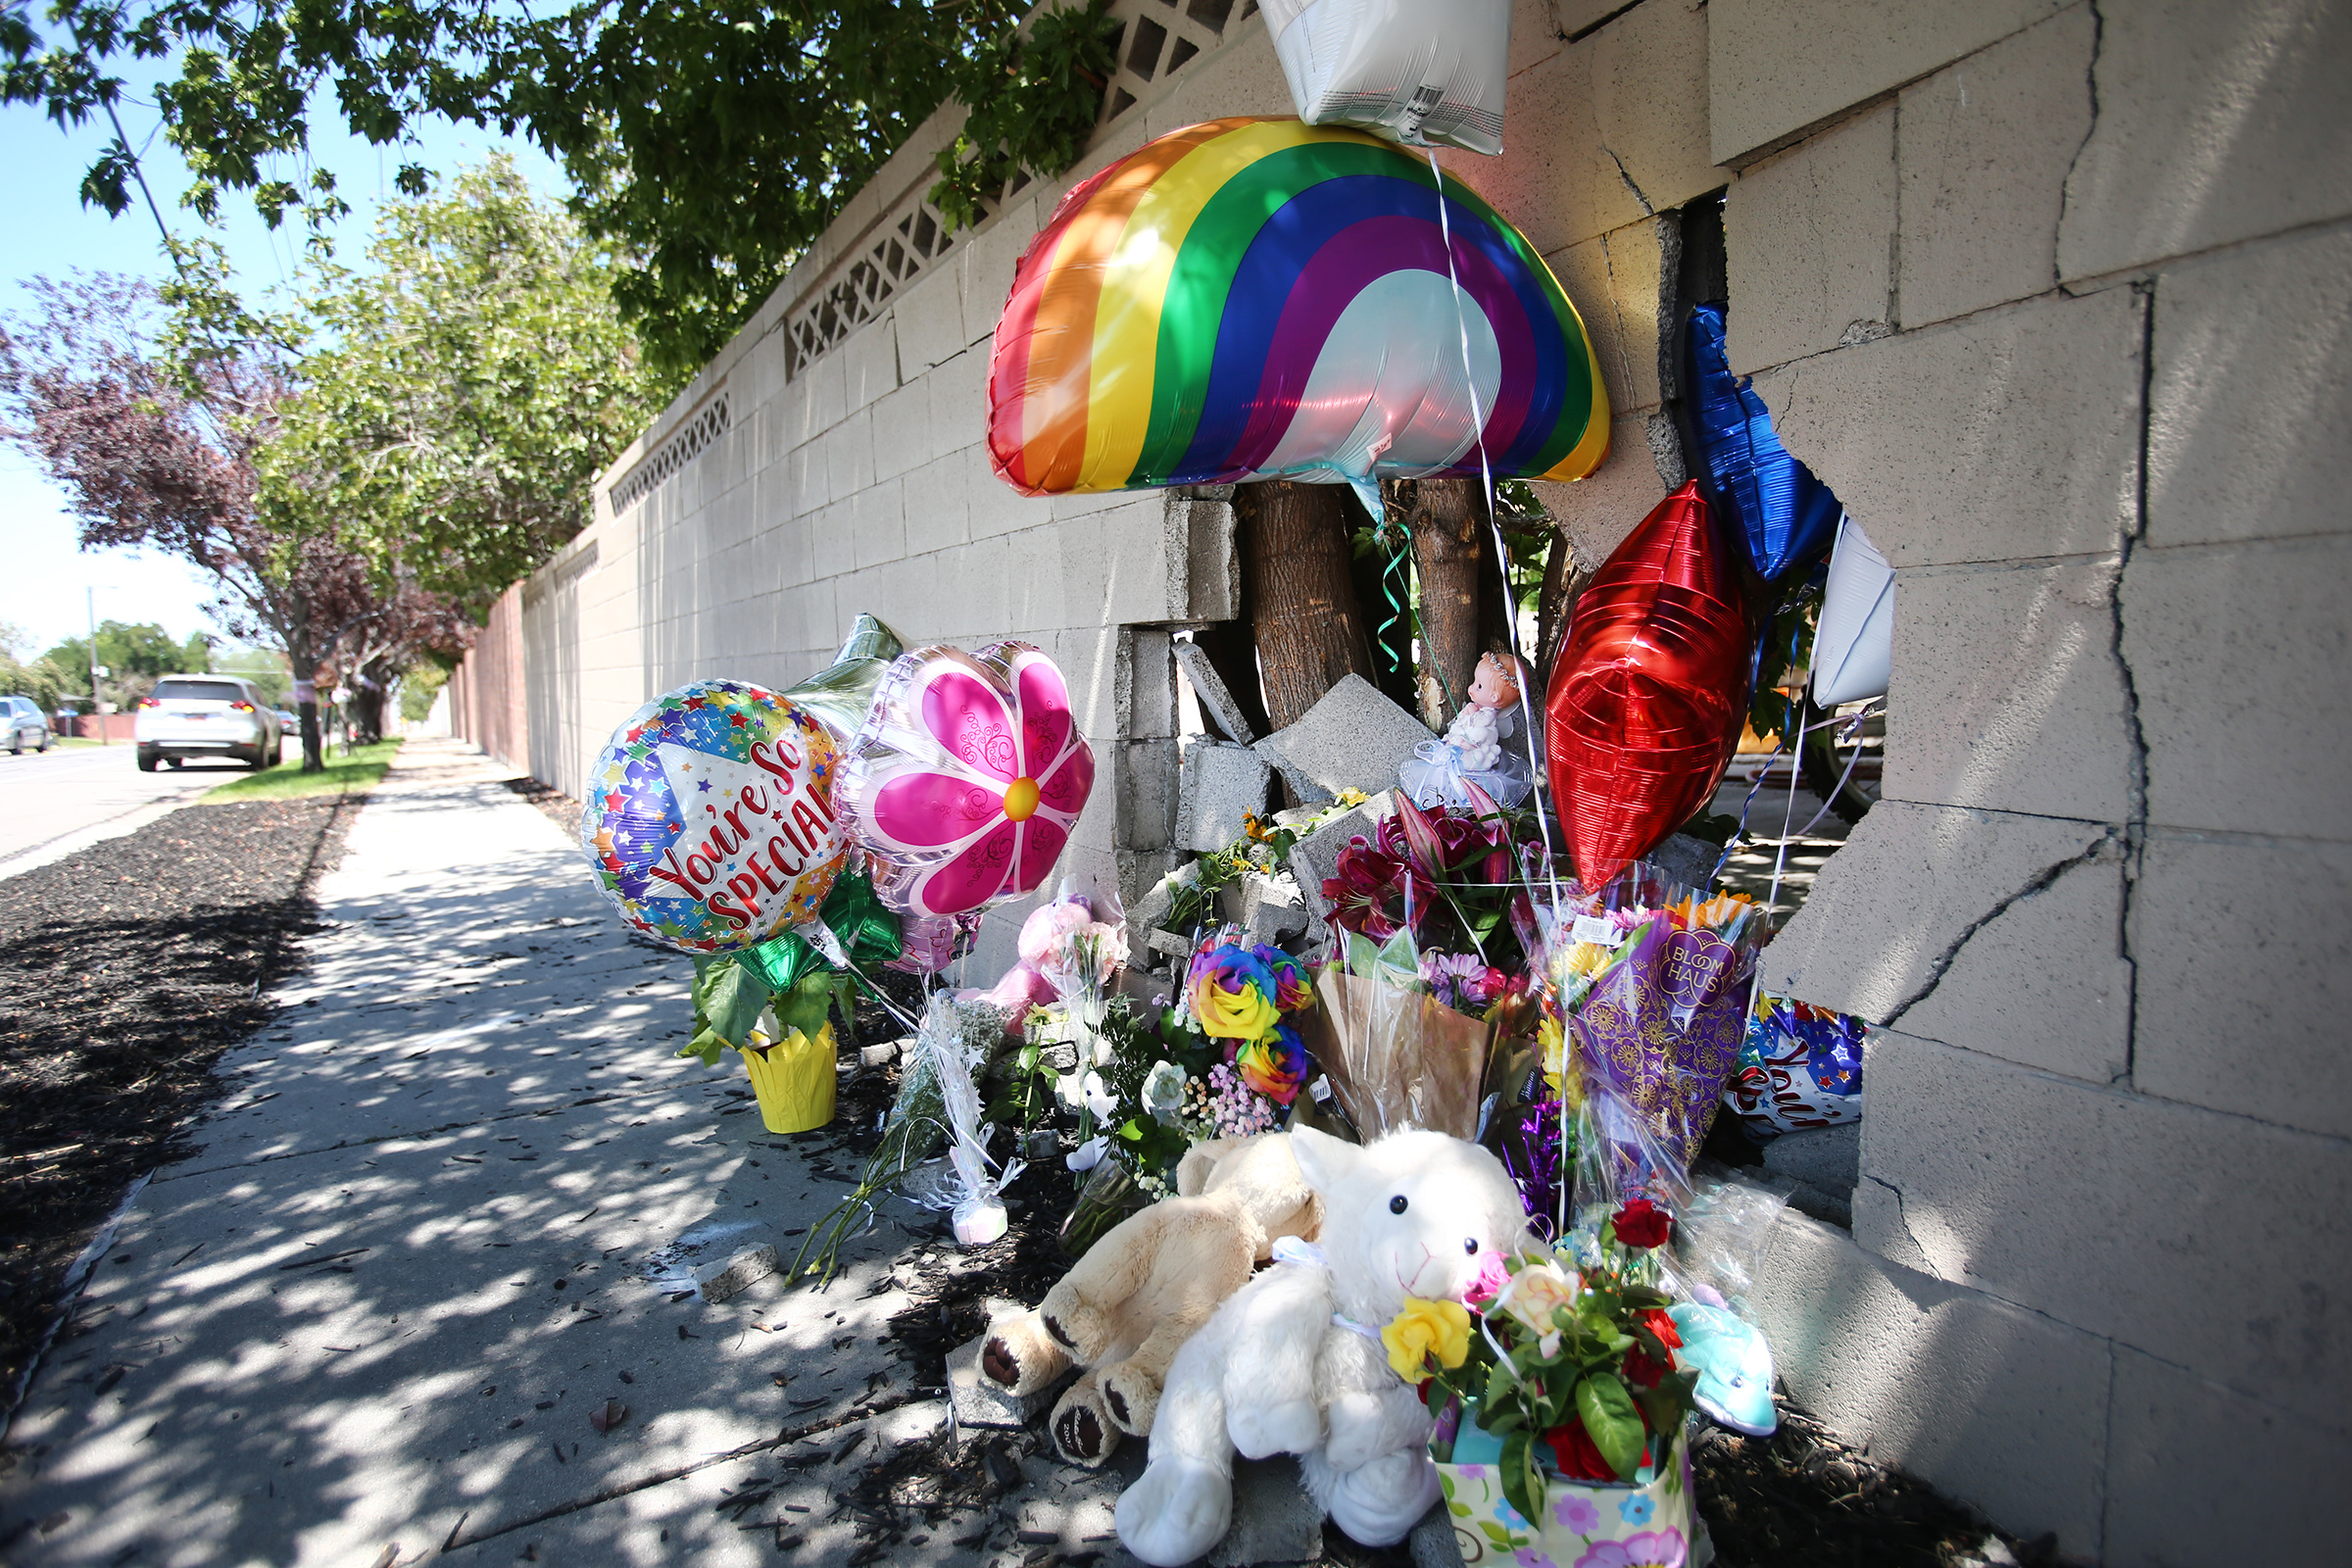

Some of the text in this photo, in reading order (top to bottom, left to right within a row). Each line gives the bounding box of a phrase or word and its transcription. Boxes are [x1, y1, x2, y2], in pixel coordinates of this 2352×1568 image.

[706, 782, 835, 932] SPECIAL
[1672, 946, 1725, 976] BLOOM
[1667, 962, 1719, 993] HAUS
